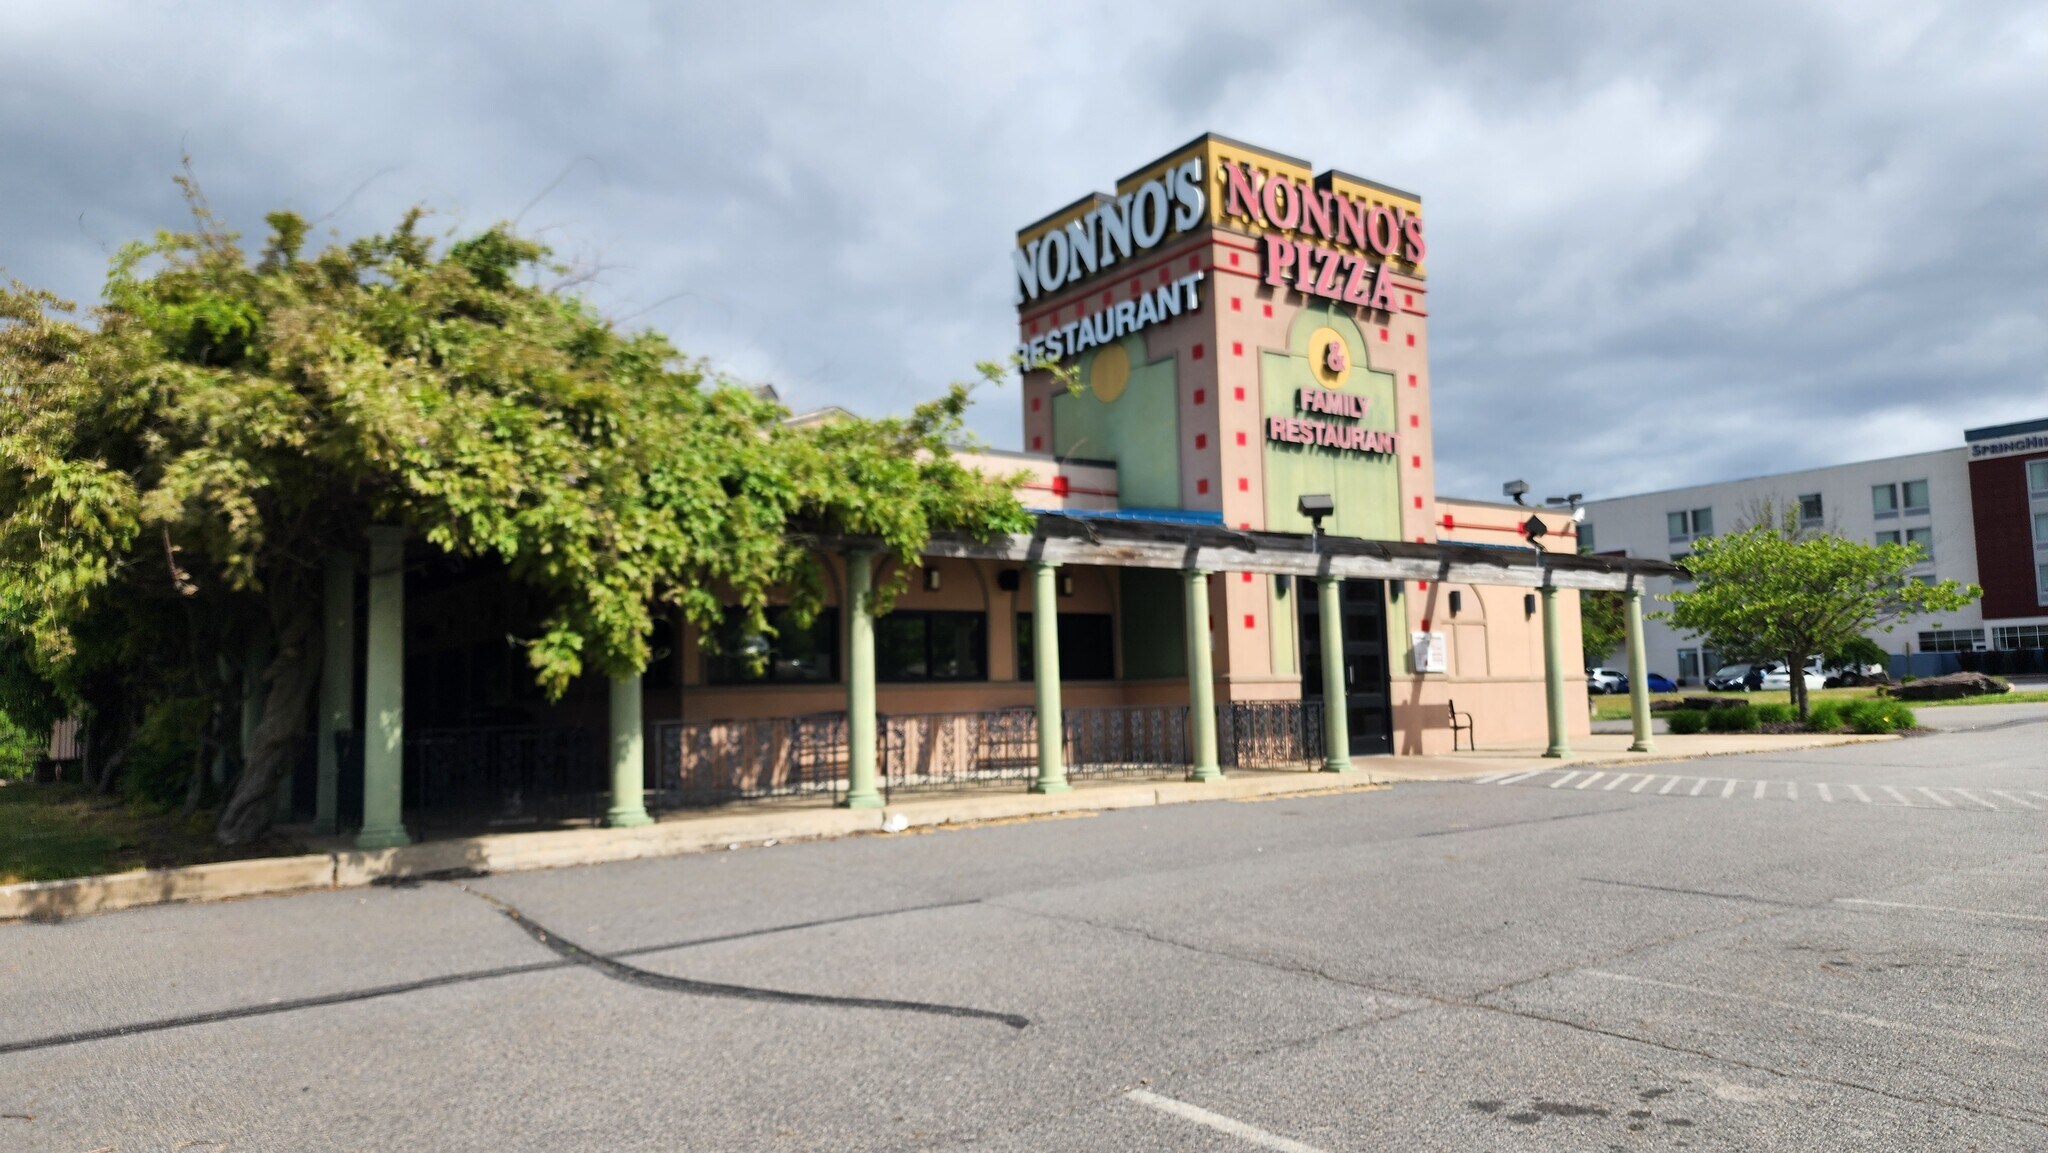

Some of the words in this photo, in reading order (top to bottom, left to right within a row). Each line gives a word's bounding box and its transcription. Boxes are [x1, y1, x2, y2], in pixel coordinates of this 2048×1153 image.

[1012, 157, 1204, 304] NONNO'S
[1225, 161, 1425, 263] NONNO'S
[1264, 234, 1398, 312] PIZZA
[1016, 271, 1204, 373] RESTAURANT
[1327, 341, 1345, 372] &
[1270, 416, 1403, 454] RESTAURANT
[1300, 387, 1370, 418] FAMILY
